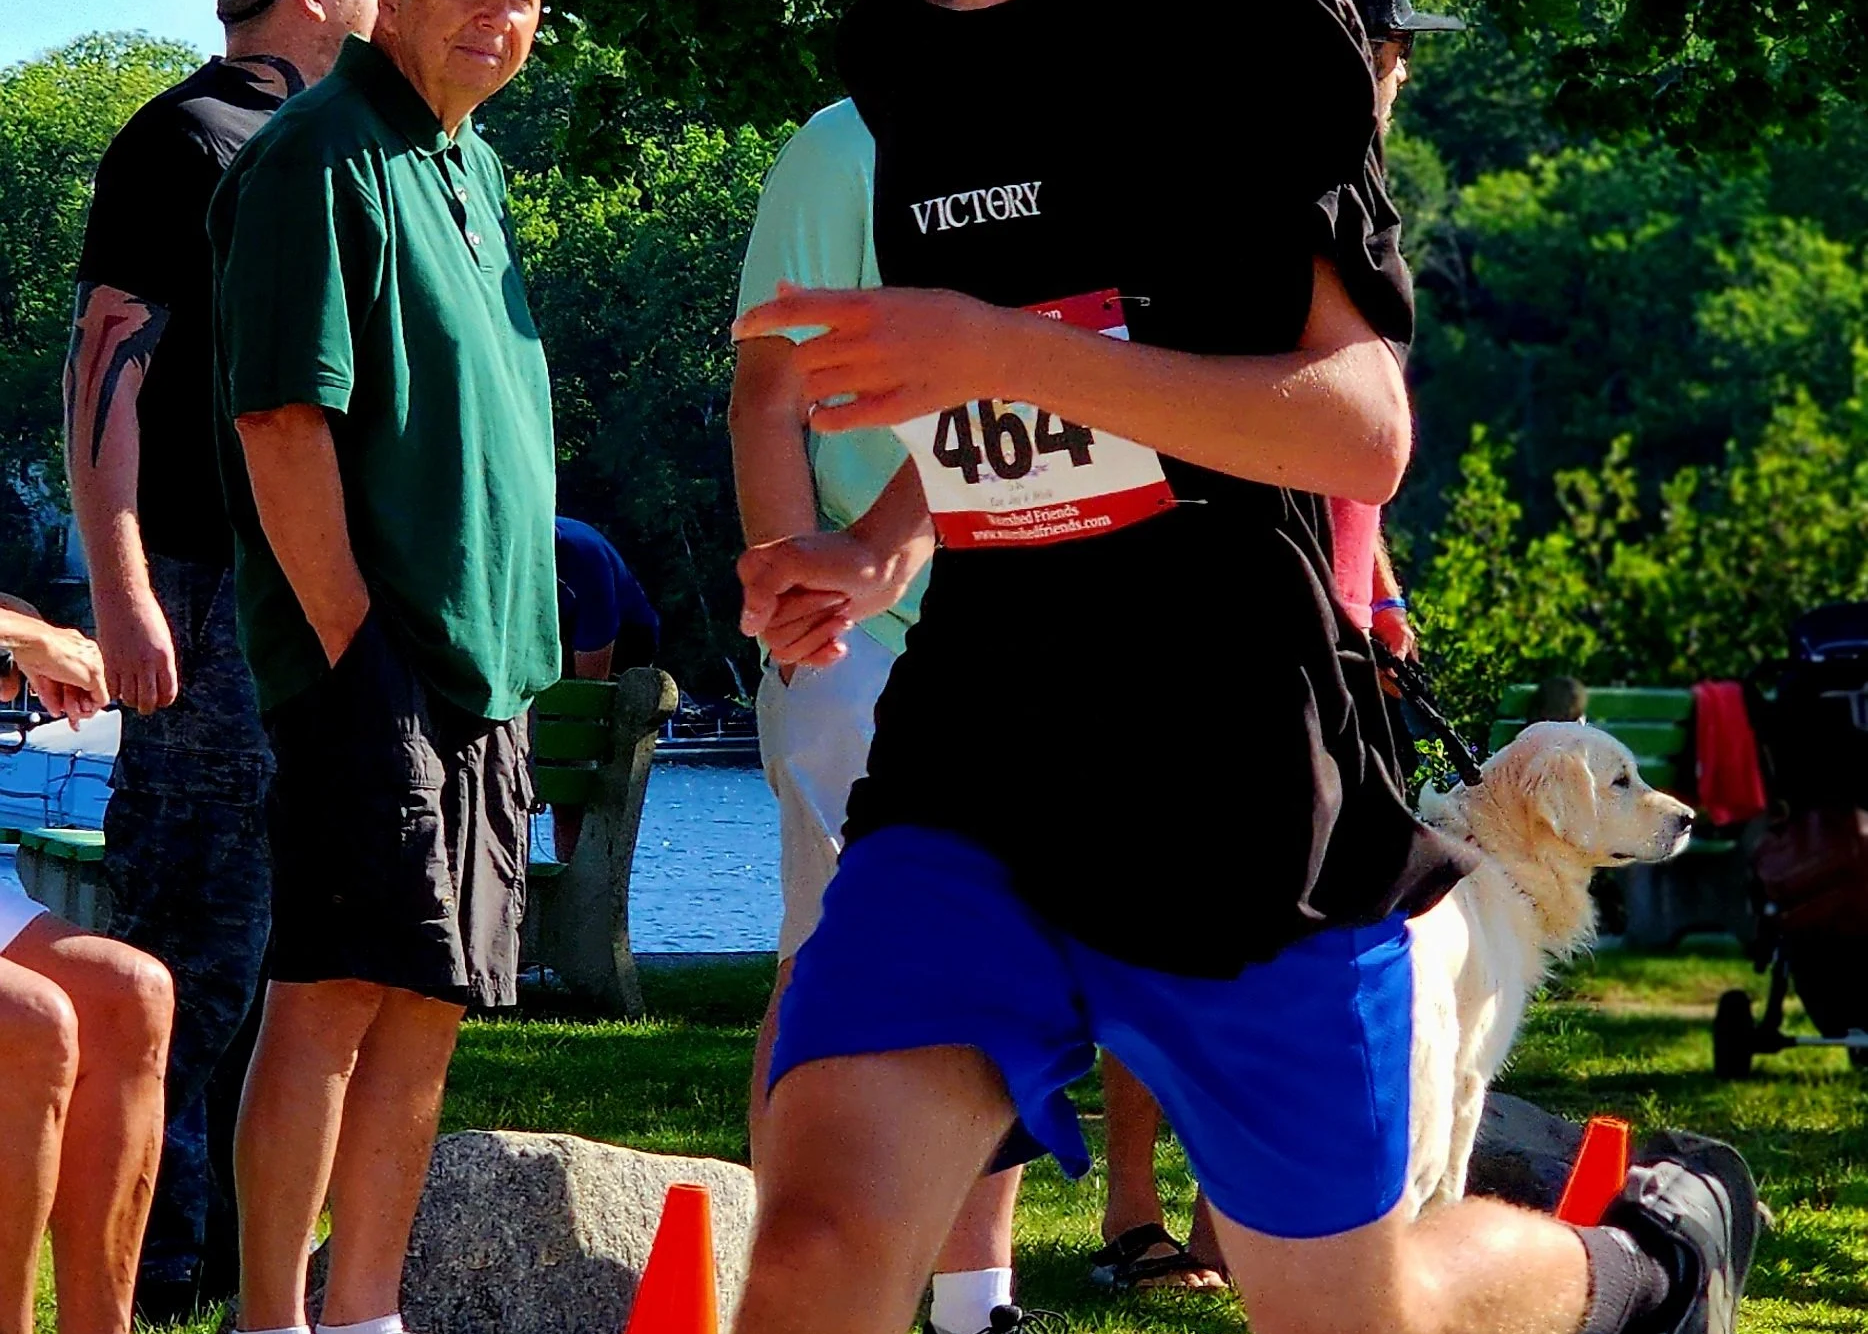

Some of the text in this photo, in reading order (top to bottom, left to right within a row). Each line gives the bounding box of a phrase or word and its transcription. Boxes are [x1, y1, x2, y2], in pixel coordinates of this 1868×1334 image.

[910, 181, 1042, 235] VICTORY
[933, 399, 1095, 484] 464
[1033, 504, 1079, 523] Friends
